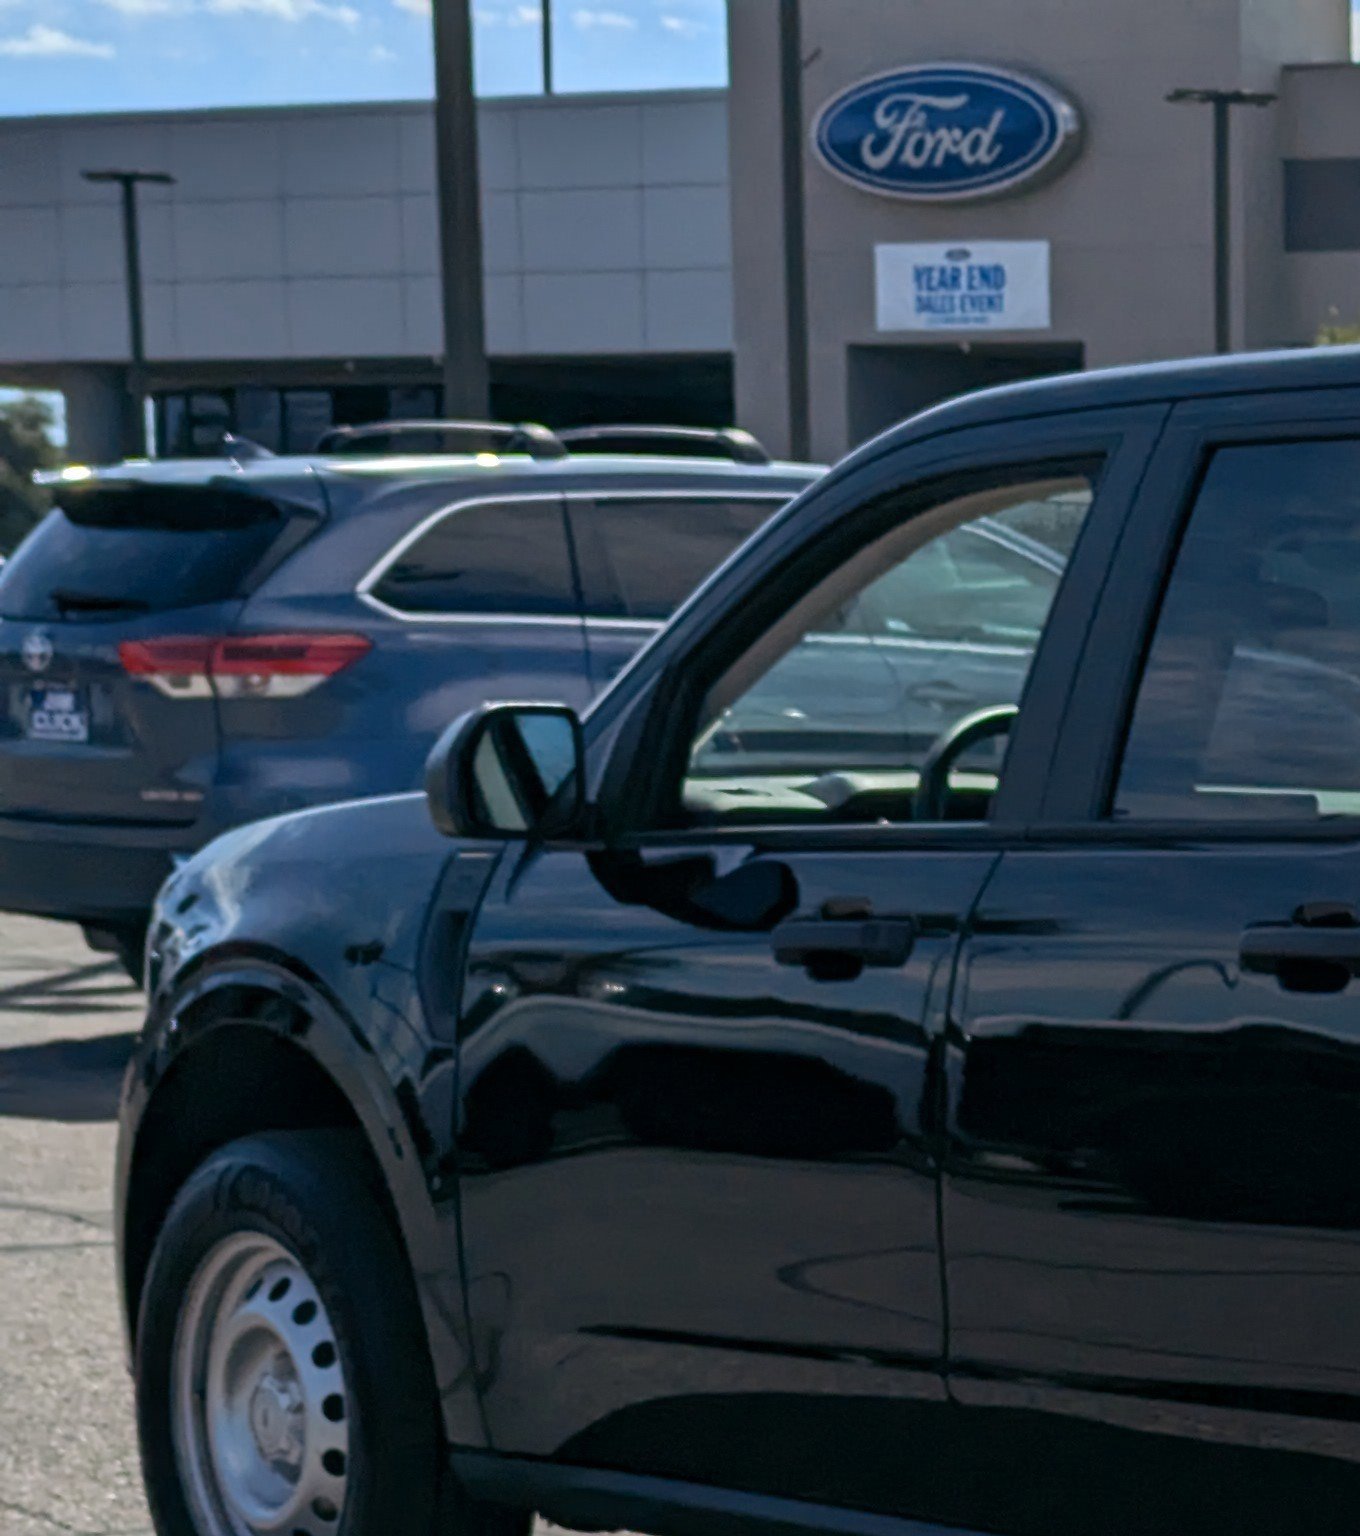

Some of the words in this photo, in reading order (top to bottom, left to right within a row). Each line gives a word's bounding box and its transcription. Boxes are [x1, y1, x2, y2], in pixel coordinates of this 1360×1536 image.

[861, 93, 1005, 170] Ford
[913, 264, 962, 292] YEAR
[967, 264, 1006, 291] END
